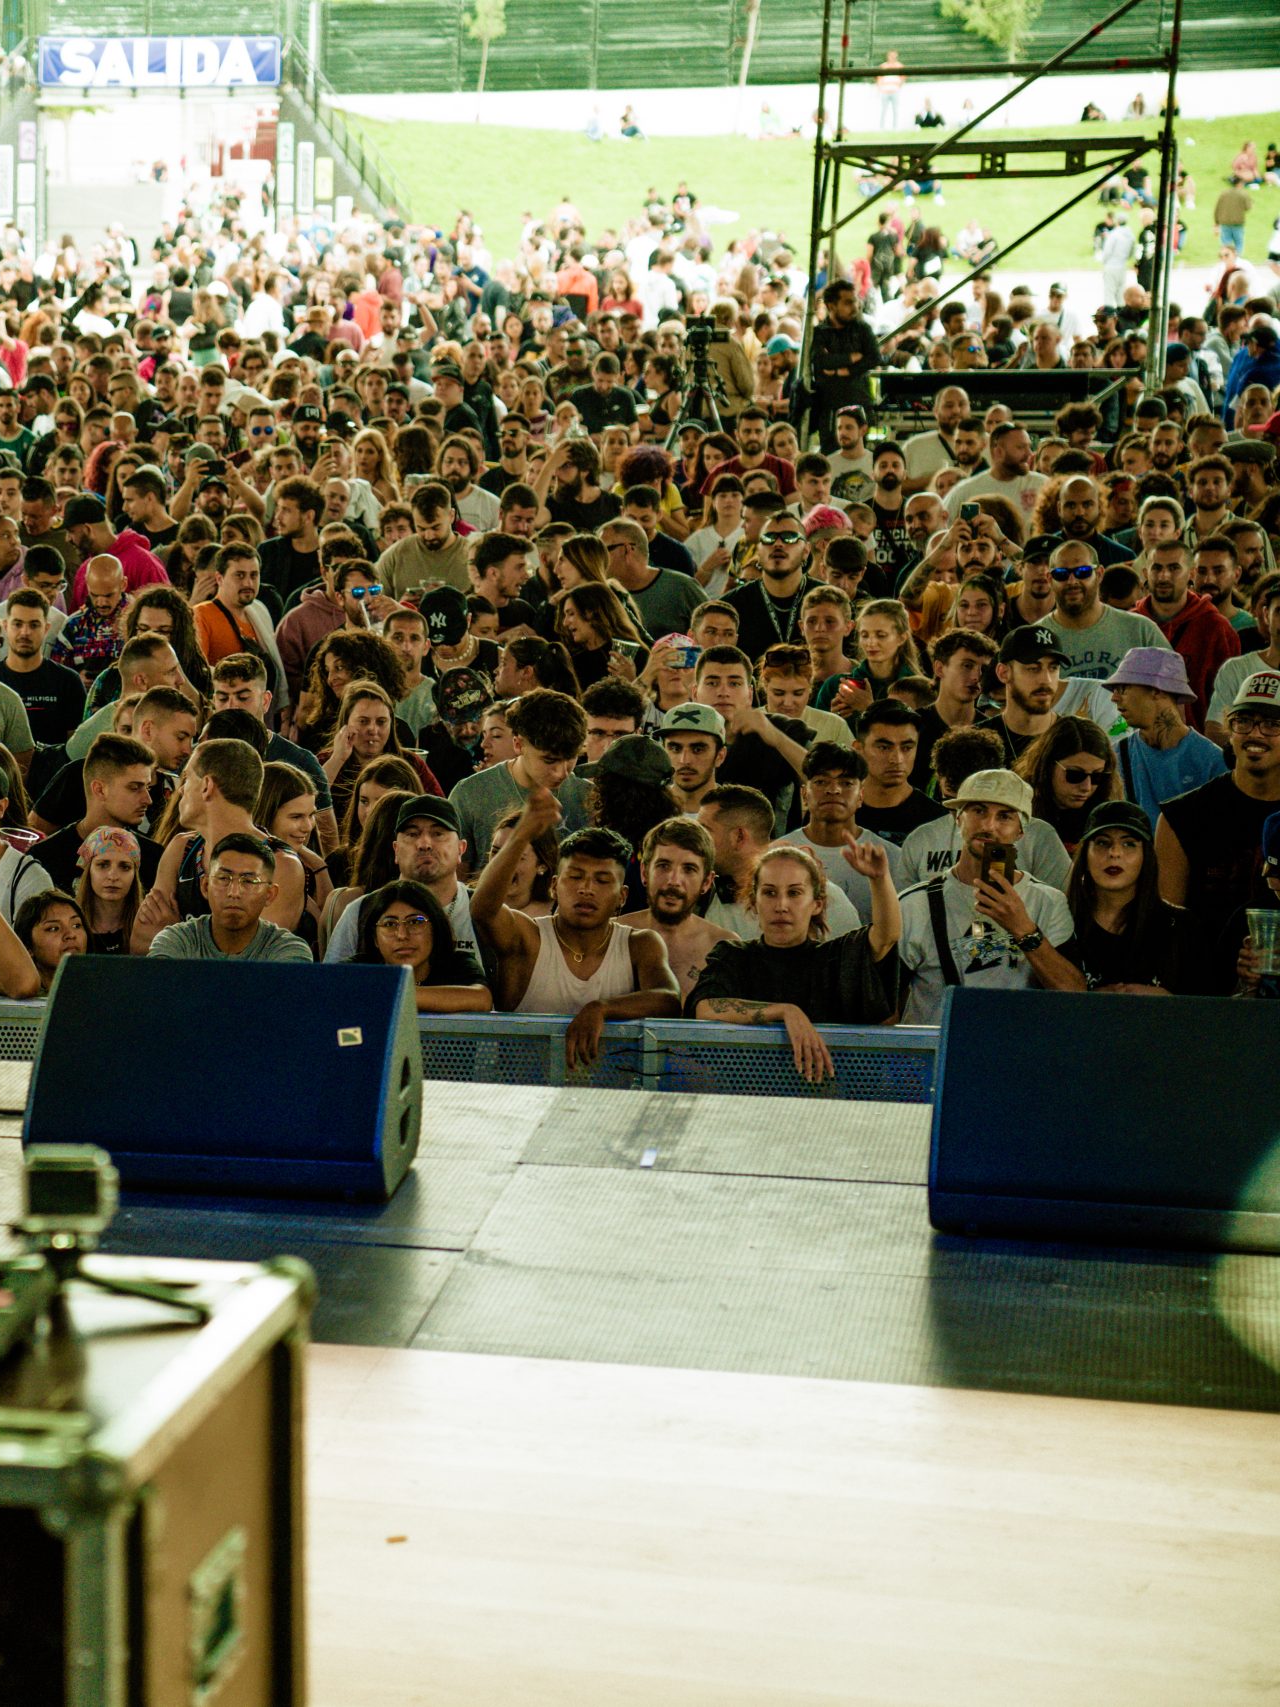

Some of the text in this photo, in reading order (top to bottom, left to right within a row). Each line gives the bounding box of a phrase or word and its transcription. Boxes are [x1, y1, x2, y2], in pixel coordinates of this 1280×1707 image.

[59, 38, 259, 86] SALIDA
[430, 612, 447, 629] NY
[1035, 629, 1053, 645] NY
[926, 848, 962, 873] WA
